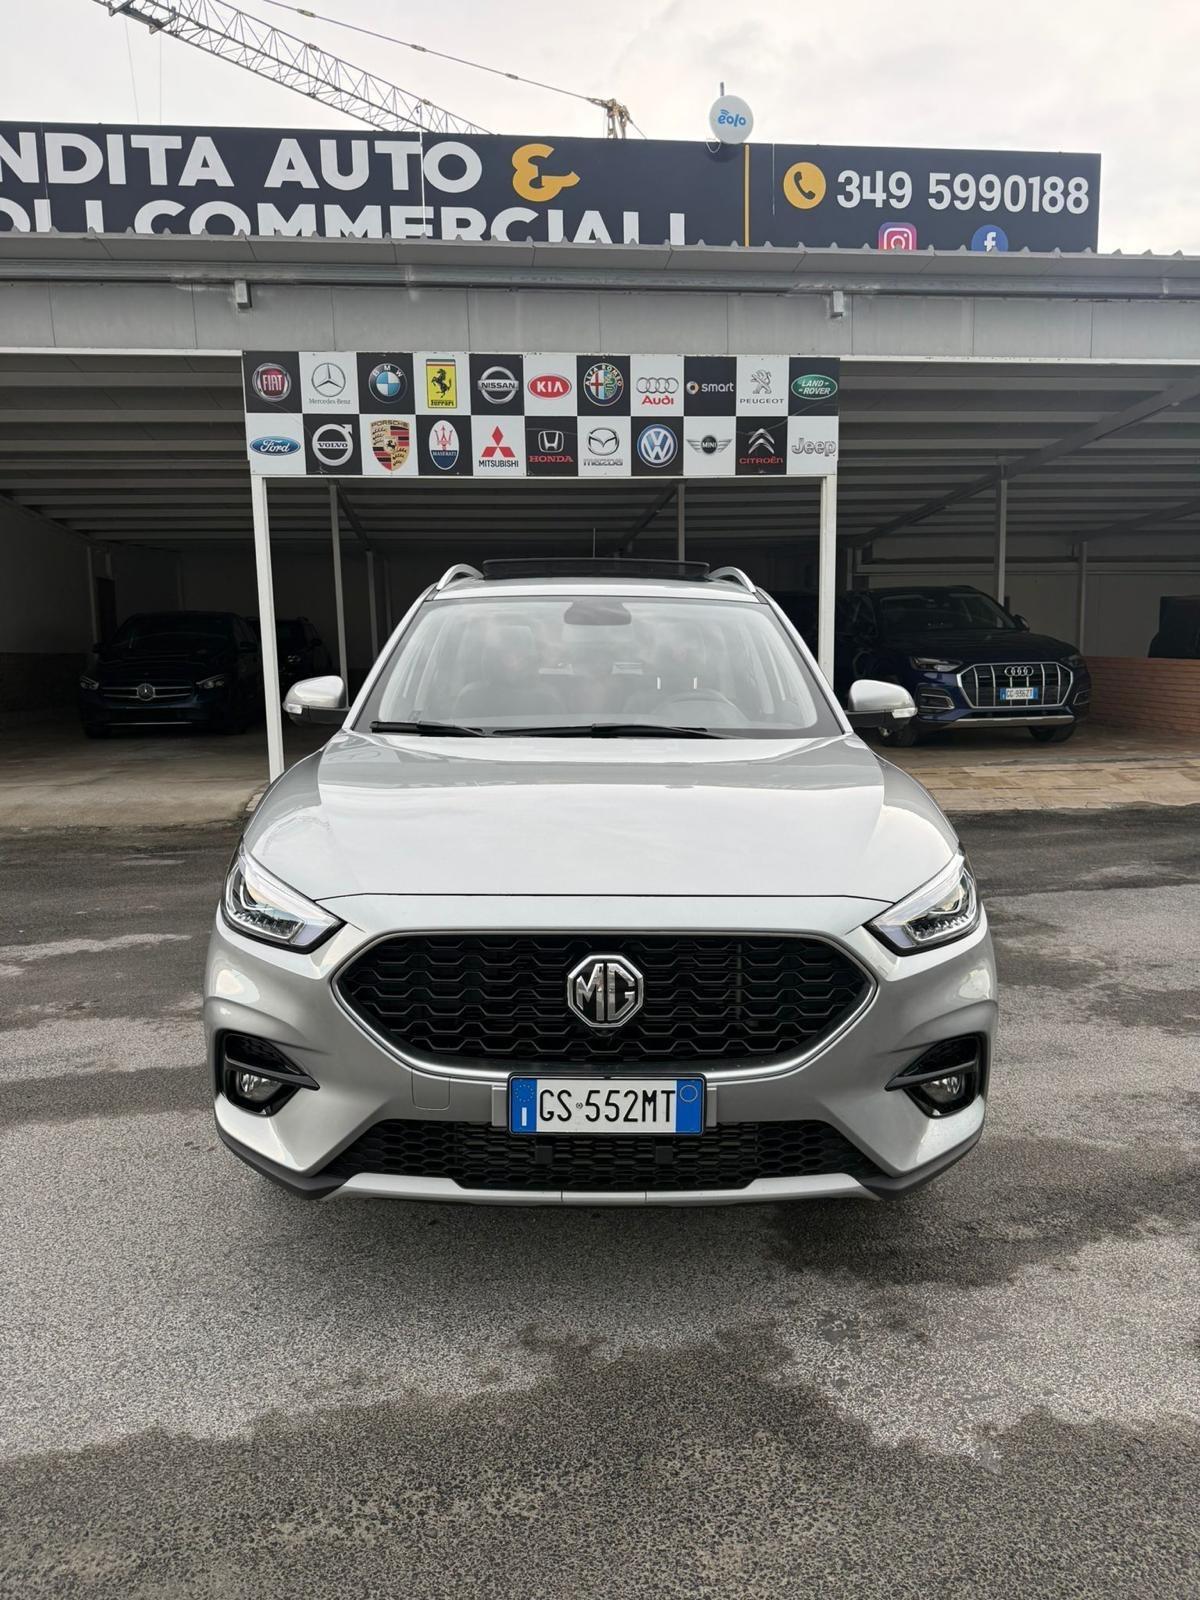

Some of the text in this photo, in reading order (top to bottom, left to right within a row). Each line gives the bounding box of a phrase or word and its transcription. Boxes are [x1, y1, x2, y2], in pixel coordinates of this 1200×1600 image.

[264, 138, 483, 193] AUTO
[836, 170, 1089, 215] 349 5990188
[262, 374, 283, 391] FIAT
[536, 380, 564, 393] KIA
[701, 382, 735, 393] smart
[641, 395, 675, 405] Audi
[371, 419, 410, 428] PORSCHE
[260, 440, 290, 452] Ford
[791, 437, 836, 456] Jeep
[478, 460, 519, 468] MITSUBISHI
[576, 963, 636, 1022] MG
[539, 1089, 573, 1123] GS
[584, 1089, 676, 1123] 552MT
